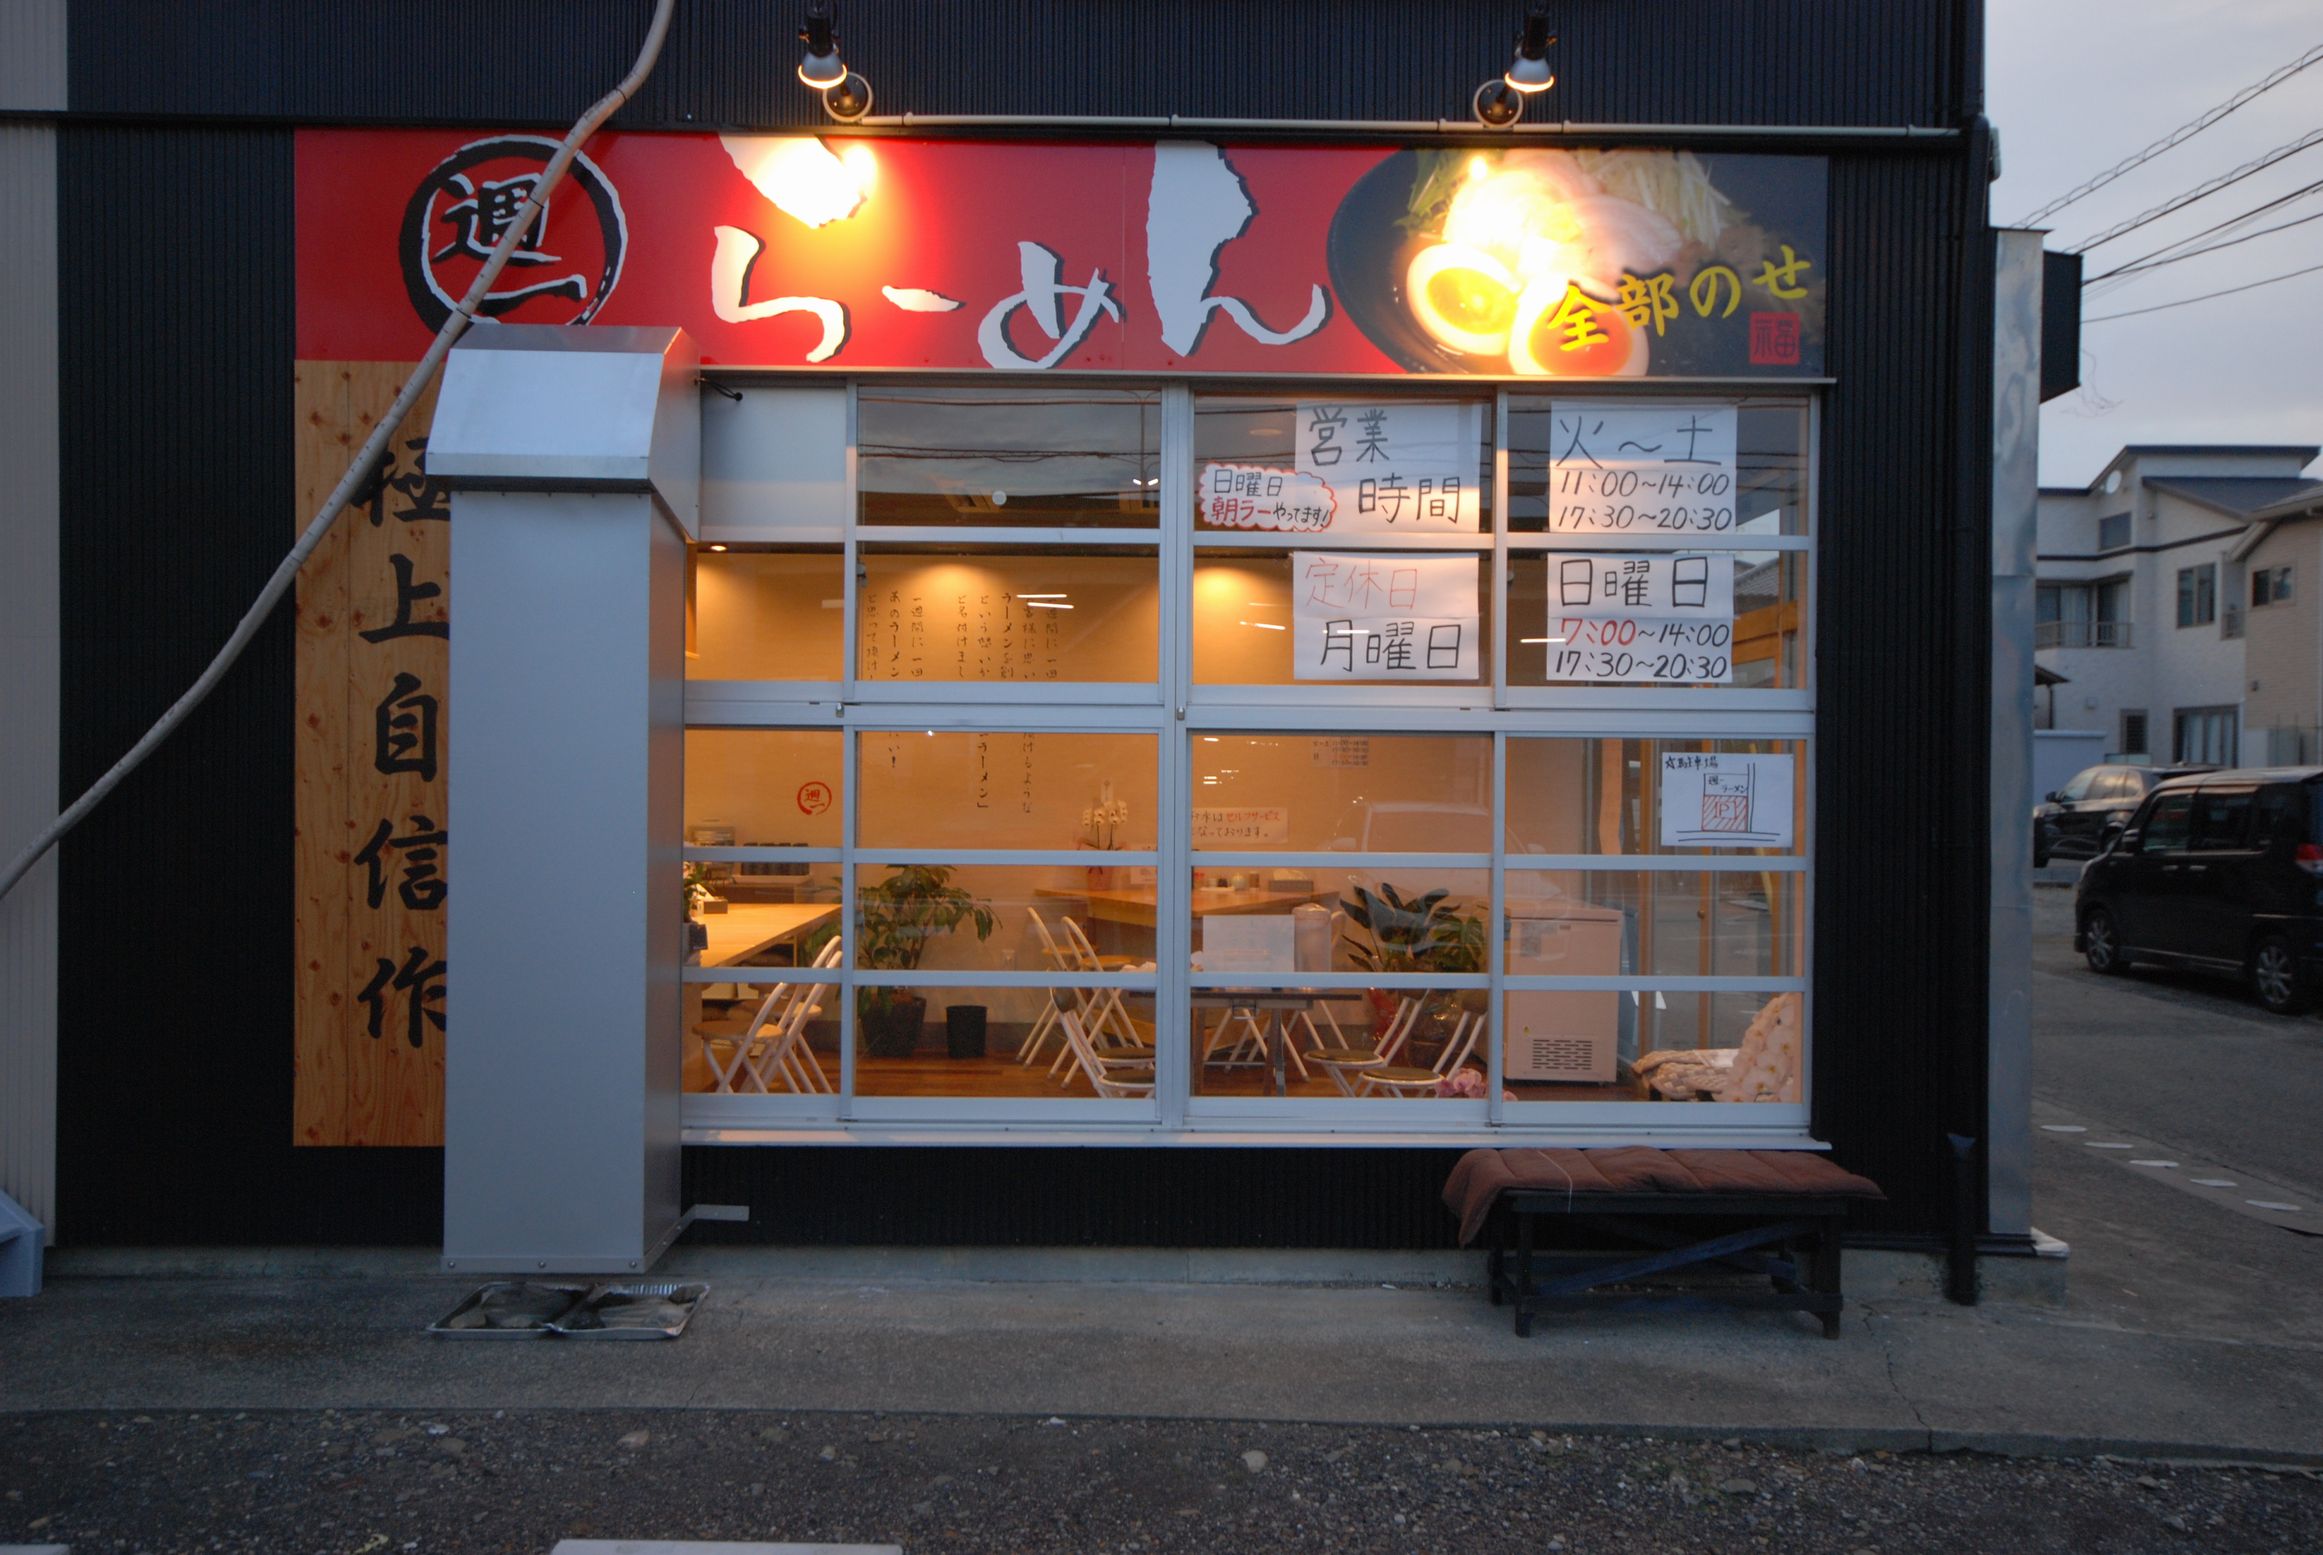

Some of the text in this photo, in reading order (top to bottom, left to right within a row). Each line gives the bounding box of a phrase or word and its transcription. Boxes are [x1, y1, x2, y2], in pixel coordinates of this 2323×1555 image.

[712, 136, 1333, 369] らーめん
[1545, 246, 1811, 352] 全部のせ
[1308, 408, 1390, 466] 営業
[1214, 469, 1283, 497] 日曜日
[1358, 473, 1461, 524] 時間
[1306, 557, 1418, 610] 定休日
[1560, 556, 1709, 608] 日曜日
[1320, 619, 1462, 672] 月曜日
[350, 436, 450, 1048] 極上自信作
